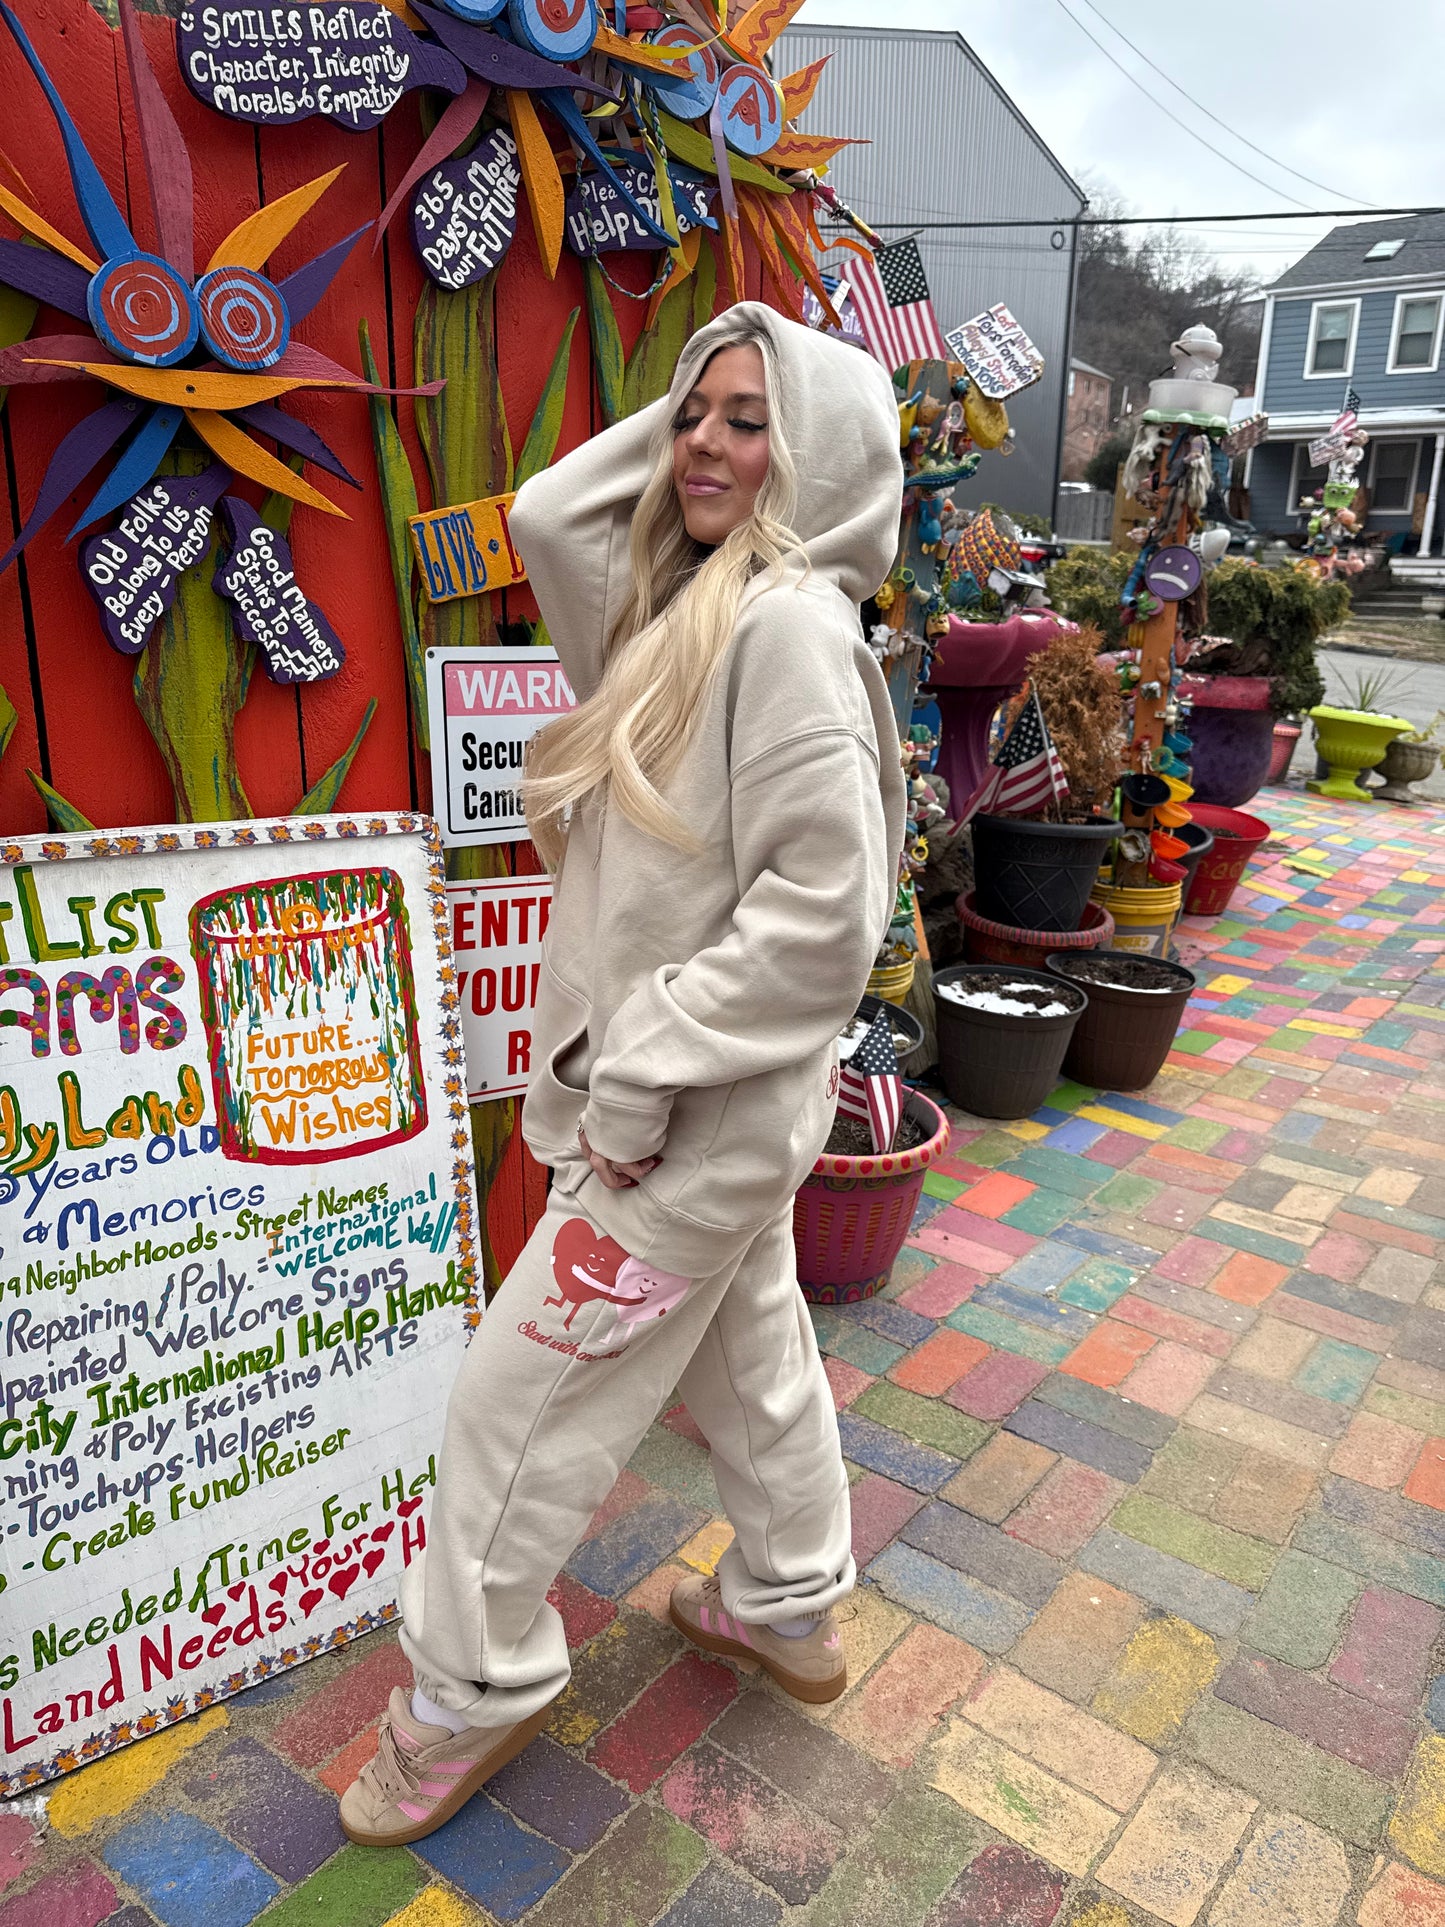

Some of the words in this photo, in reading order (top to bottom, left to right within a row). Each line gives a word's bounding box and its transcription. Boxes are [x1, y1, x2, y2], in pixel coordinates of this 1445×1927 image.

[189, 51, 309, 84] Character,
[307, 45, 410, 82] Integrity
[201, 6, 303, 42] SMILES
[311, 5, 393, 40] Reflect
[213, 85, 297, 115] Morals
[317, 84, 403, 124] Empathy
[415, 171, 454, 230] 365
[422, 214, 468, 271] Days
[467, 128, 517, 194] Mould
[439, 252, 476, 289] Your
[466, 166, 521, 268] FUTURE
[569, 204, 630, 251] Help
[88, 538, 128, 584] Old
[120, 485, 170, 543] Folks
[104, 555, 162, 618] Belong
[141, 534, 172, 559] To
[163, 505, 189, 533] Us
[120, 591, 163, 644] Every
[165, 505, 214, 572] Person
[412, 509, 487, 599] LIVE
[225, 575, 280, 651] Success
[236, 548, 275, 609] Stairs
[269, 608, 289, 635] To
[250, 527, 294, 588] Good
[282, 586, 339, 671] Manners
[146, 1125, 221, 1165] OLD
[261, 1095, 391, 1144] Wishes
[57, 1185, 265, 1250] Memories
[267, 1172, 437, 1258] International
[318, 1182, 388, 1219] Names
[275, 1216, 402, 1278] WELCOME
[145, 1294, 303, 1357] Welcome
[312, 1258, 408, 1308] Signs
[0, 1400, 78, 1460] City
[298, 1308, 379, 1358] Help
[386, 1260, 472, 1326] Hands
[111, 1415, 176, 1461] Poly
[330, 1320, 418, 1377] ARTS
[322, 1494, 372, 1538] For
[140, 1585, 287, 1692] Needs
